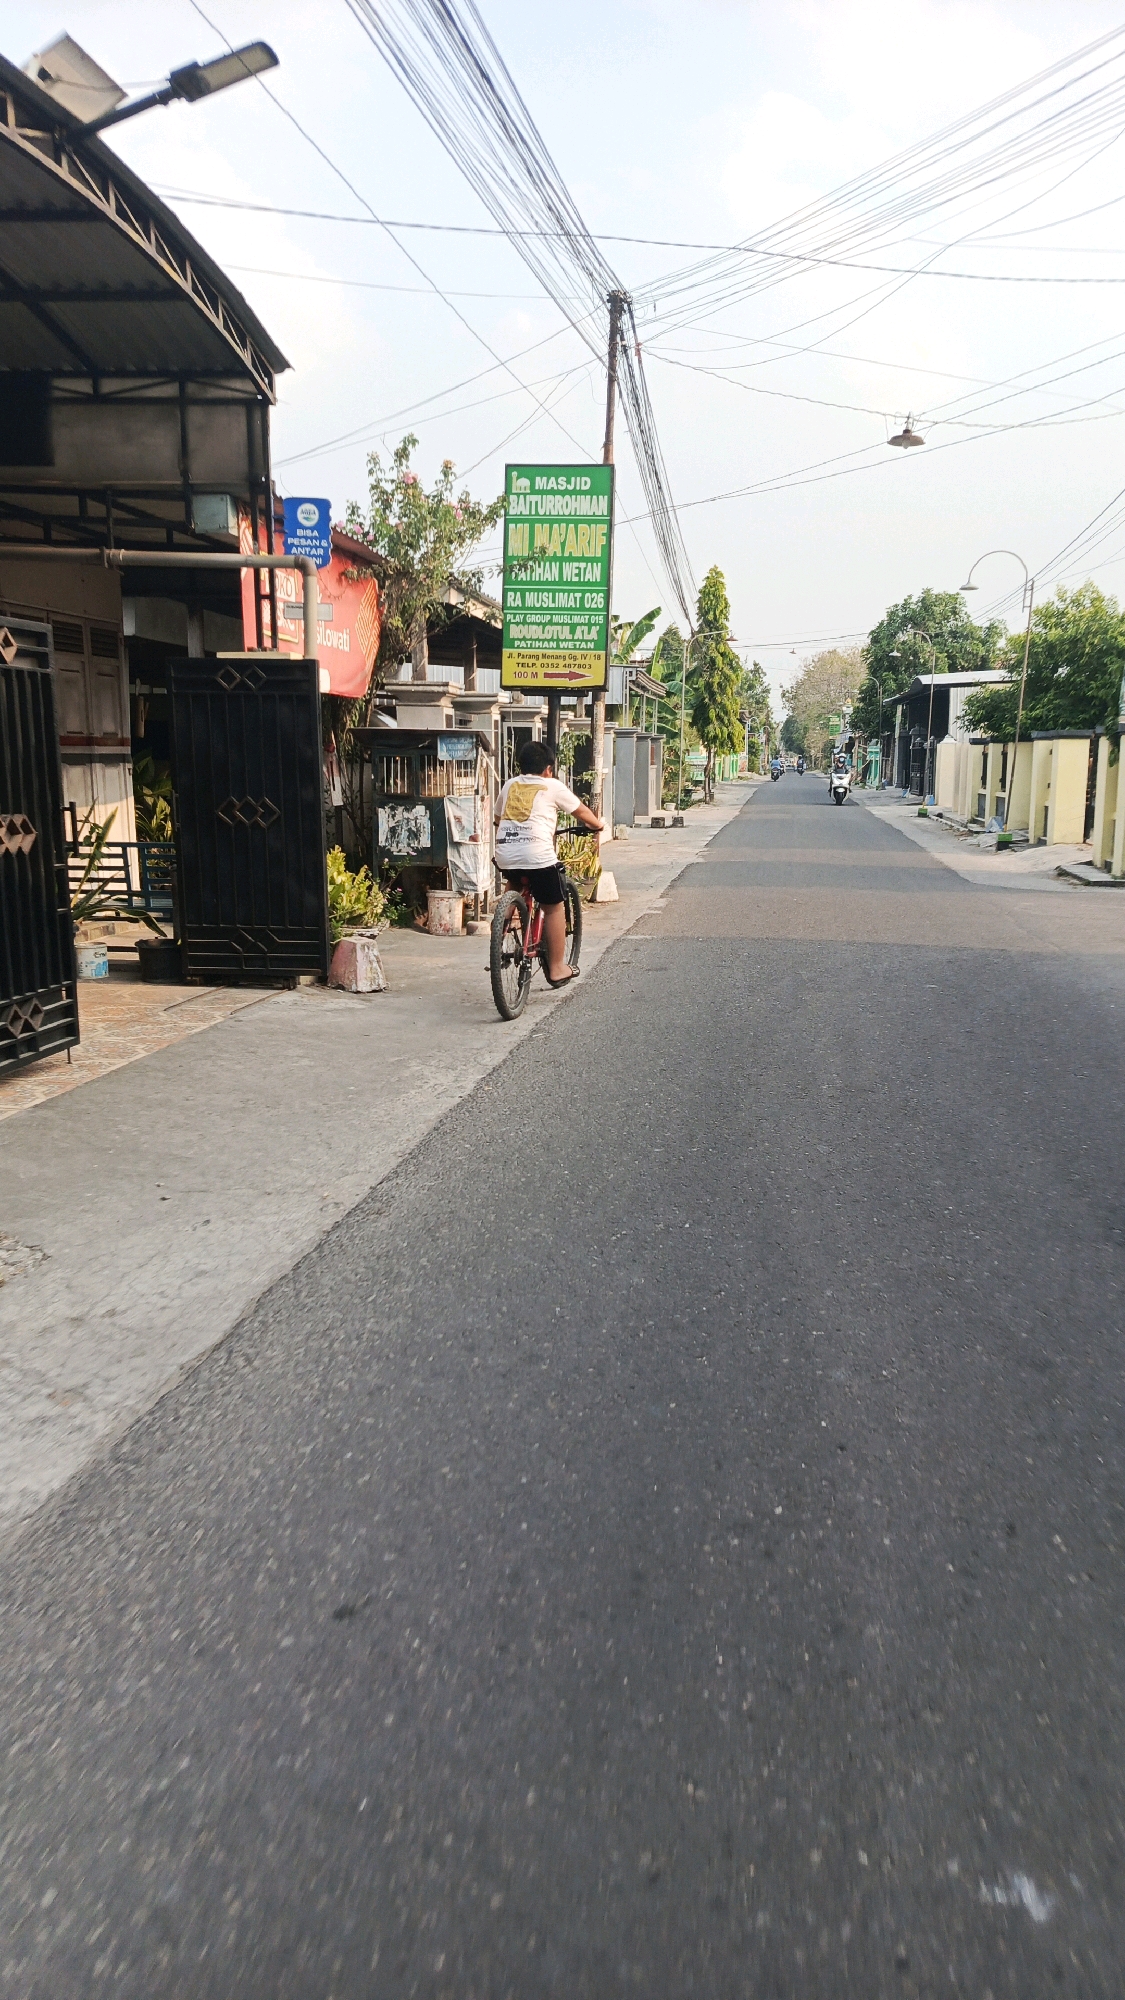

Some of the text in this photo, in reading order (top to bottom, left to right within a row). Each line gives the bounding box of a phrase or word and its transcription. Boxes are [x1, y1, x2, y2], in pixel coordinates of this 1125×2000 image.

[535, 475, 591, 491] MASJID
[509, 495, 608, 516] BAITURROHMAN
[296, 528, 319, 538] BISA
[287, 537, 328, 547] PESAN &
[507, 523, 608, 557] MI MA'ARIF
[290, 546, 324, 556] ANTAR
[562, 561, 602, 582] WETAN
[506, 591, 605, 609] RA MUSLIMAT 026
[506, 614, 604, 624] PLAY GROUP MUSLIMAT 015
[509, 624, 573, 640] ROUDLOTUL
[514, 640, 595, 649] PATIHAN WETAN
[517, 652, 540, 662] Parang
[541, 653, 567, 662] Menang
[568, 653, 579, 662] Gg.
[513, 671, 539, 679] 100 M
